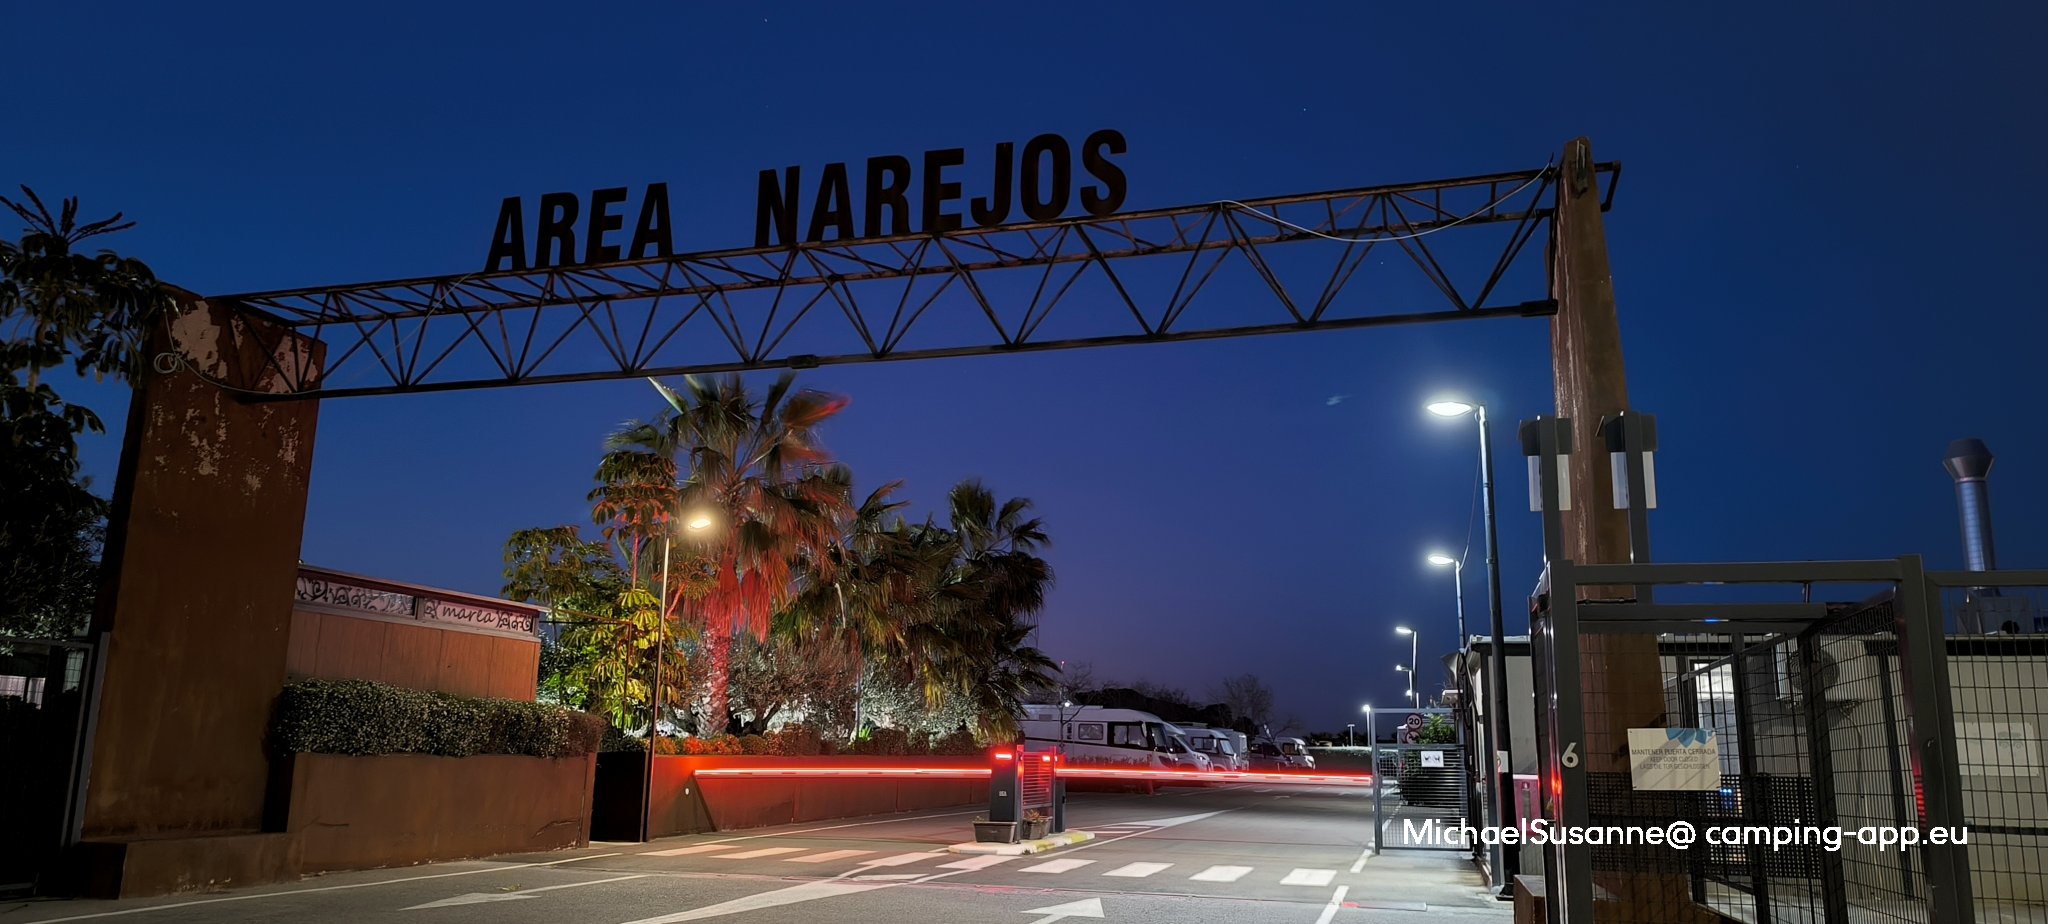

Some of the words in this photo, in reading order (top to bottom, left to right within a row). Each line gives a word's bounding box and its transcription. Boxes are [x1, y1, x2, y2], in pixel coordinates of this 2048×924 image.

[484, 182, 673, 274] AREA
[755, 129, 1128, 248] NAREJOS
[442, 606, 496, 623] marea
[1408, 717, 1420, 725] 20
[1561, 742, 1579, 768] 6
